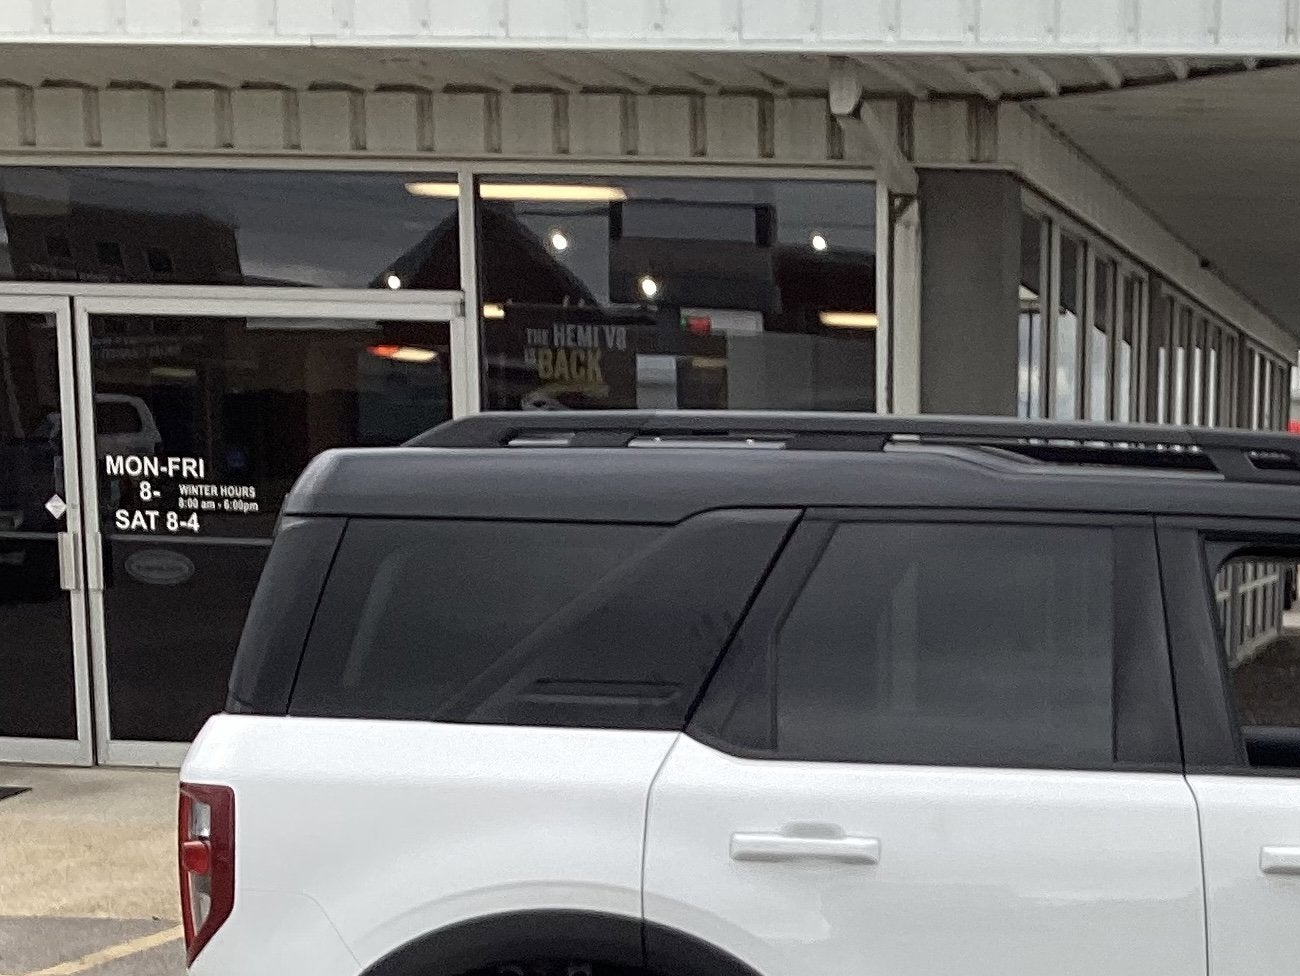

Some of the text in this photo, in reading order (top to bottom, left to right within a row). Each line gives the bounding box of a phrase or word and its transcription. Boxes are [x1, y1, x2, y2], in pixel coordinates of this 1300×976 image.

[554, 323, 599, 347] HEMI
[538, 348, 603, 382] BACK
[105, 454, 205, 479] MON-FRI
[139, 480, 162, 501] 8-
[178, 484, 256, 499] WINTER HOURS
[115, 508, 200, 532] SAT 8-4
